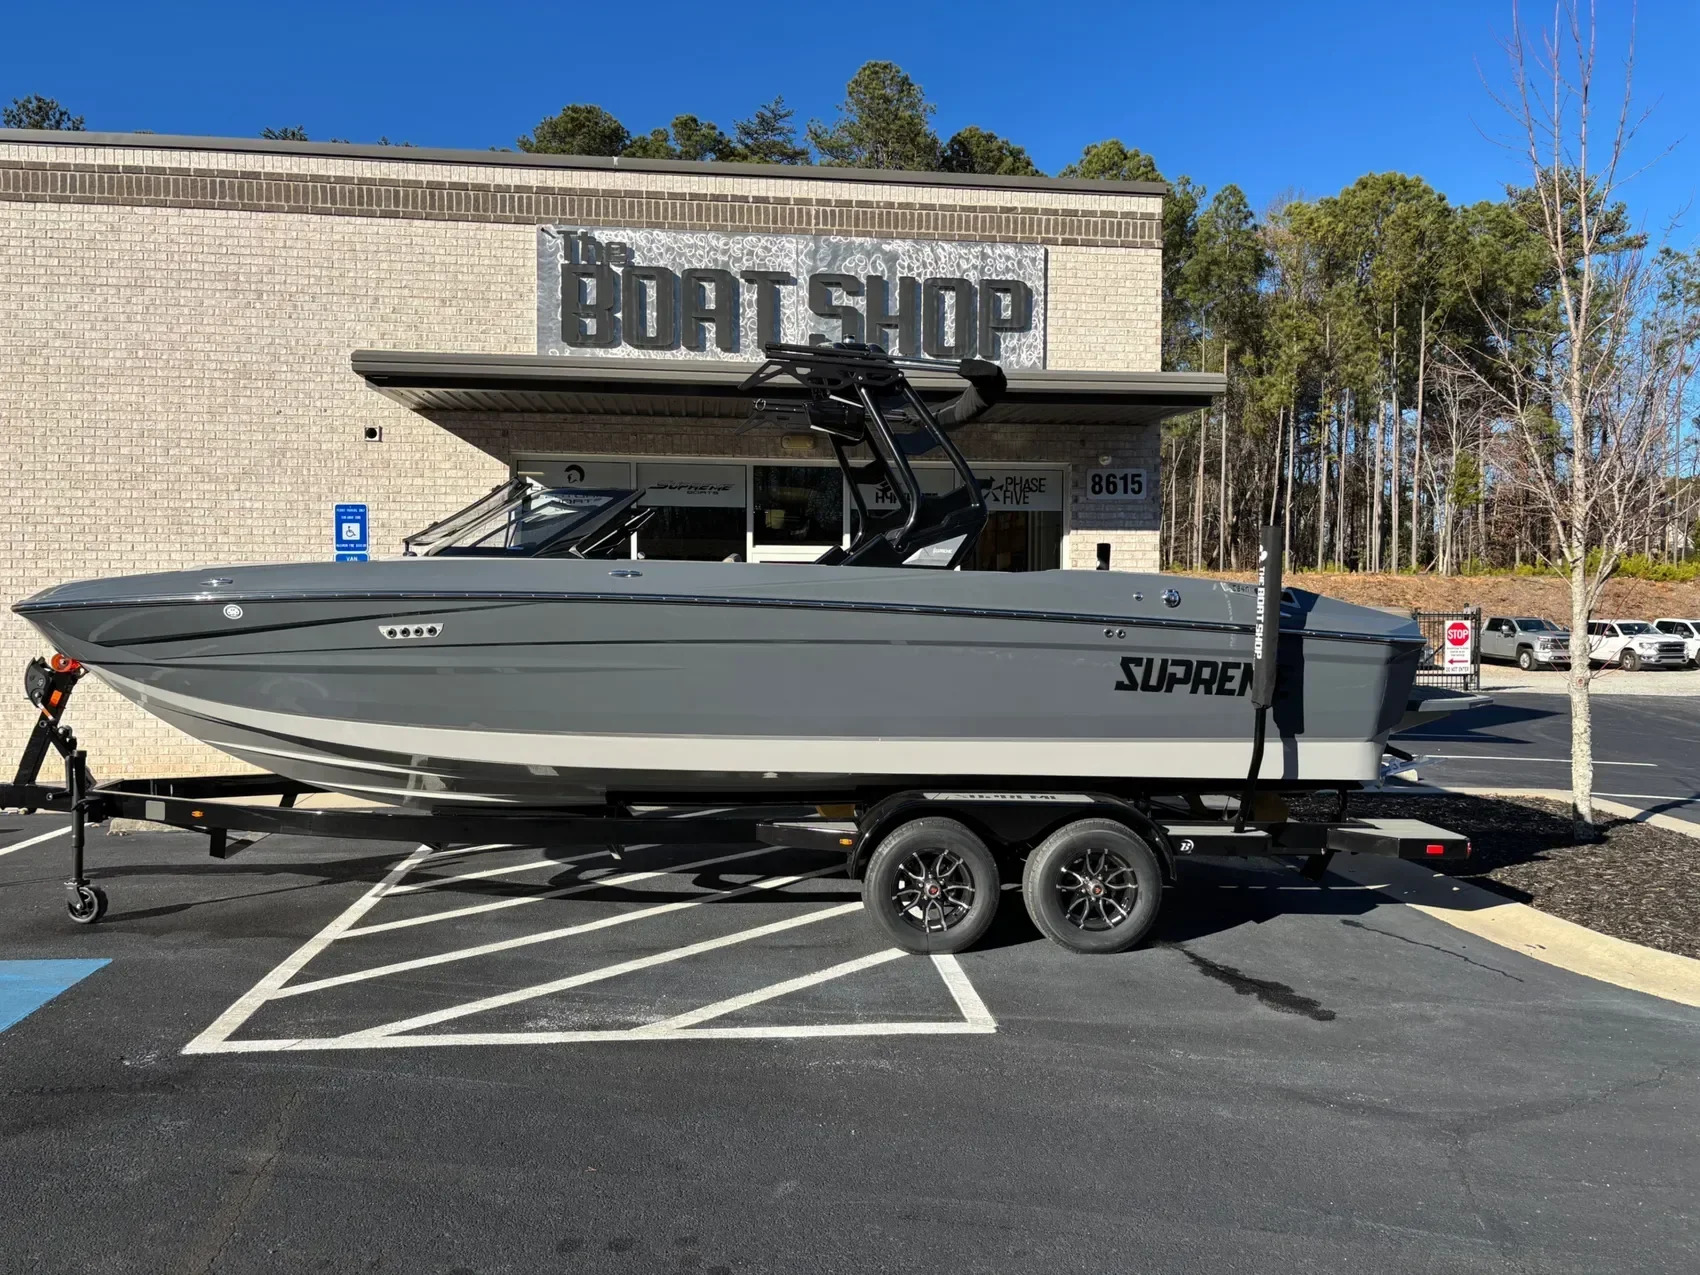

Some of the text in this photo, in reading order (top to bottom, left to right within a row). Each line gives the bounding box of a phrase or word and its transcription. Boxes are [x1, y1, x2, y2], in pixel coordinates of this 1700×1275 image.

[556, 230, 628, 265] The
[561, 264, 1029, 356] BOAT SHOP
[1003, 491, 1030, 505] FIVE
[1005, 476, 1047, 493] PHASE
[1091, 473, 1143, 495] 8615
[1256, 587, 1265, 623] BOAT
[1254, 623, 1264, 660] SHOP
[1447, 629, 1469, 640] STOP
